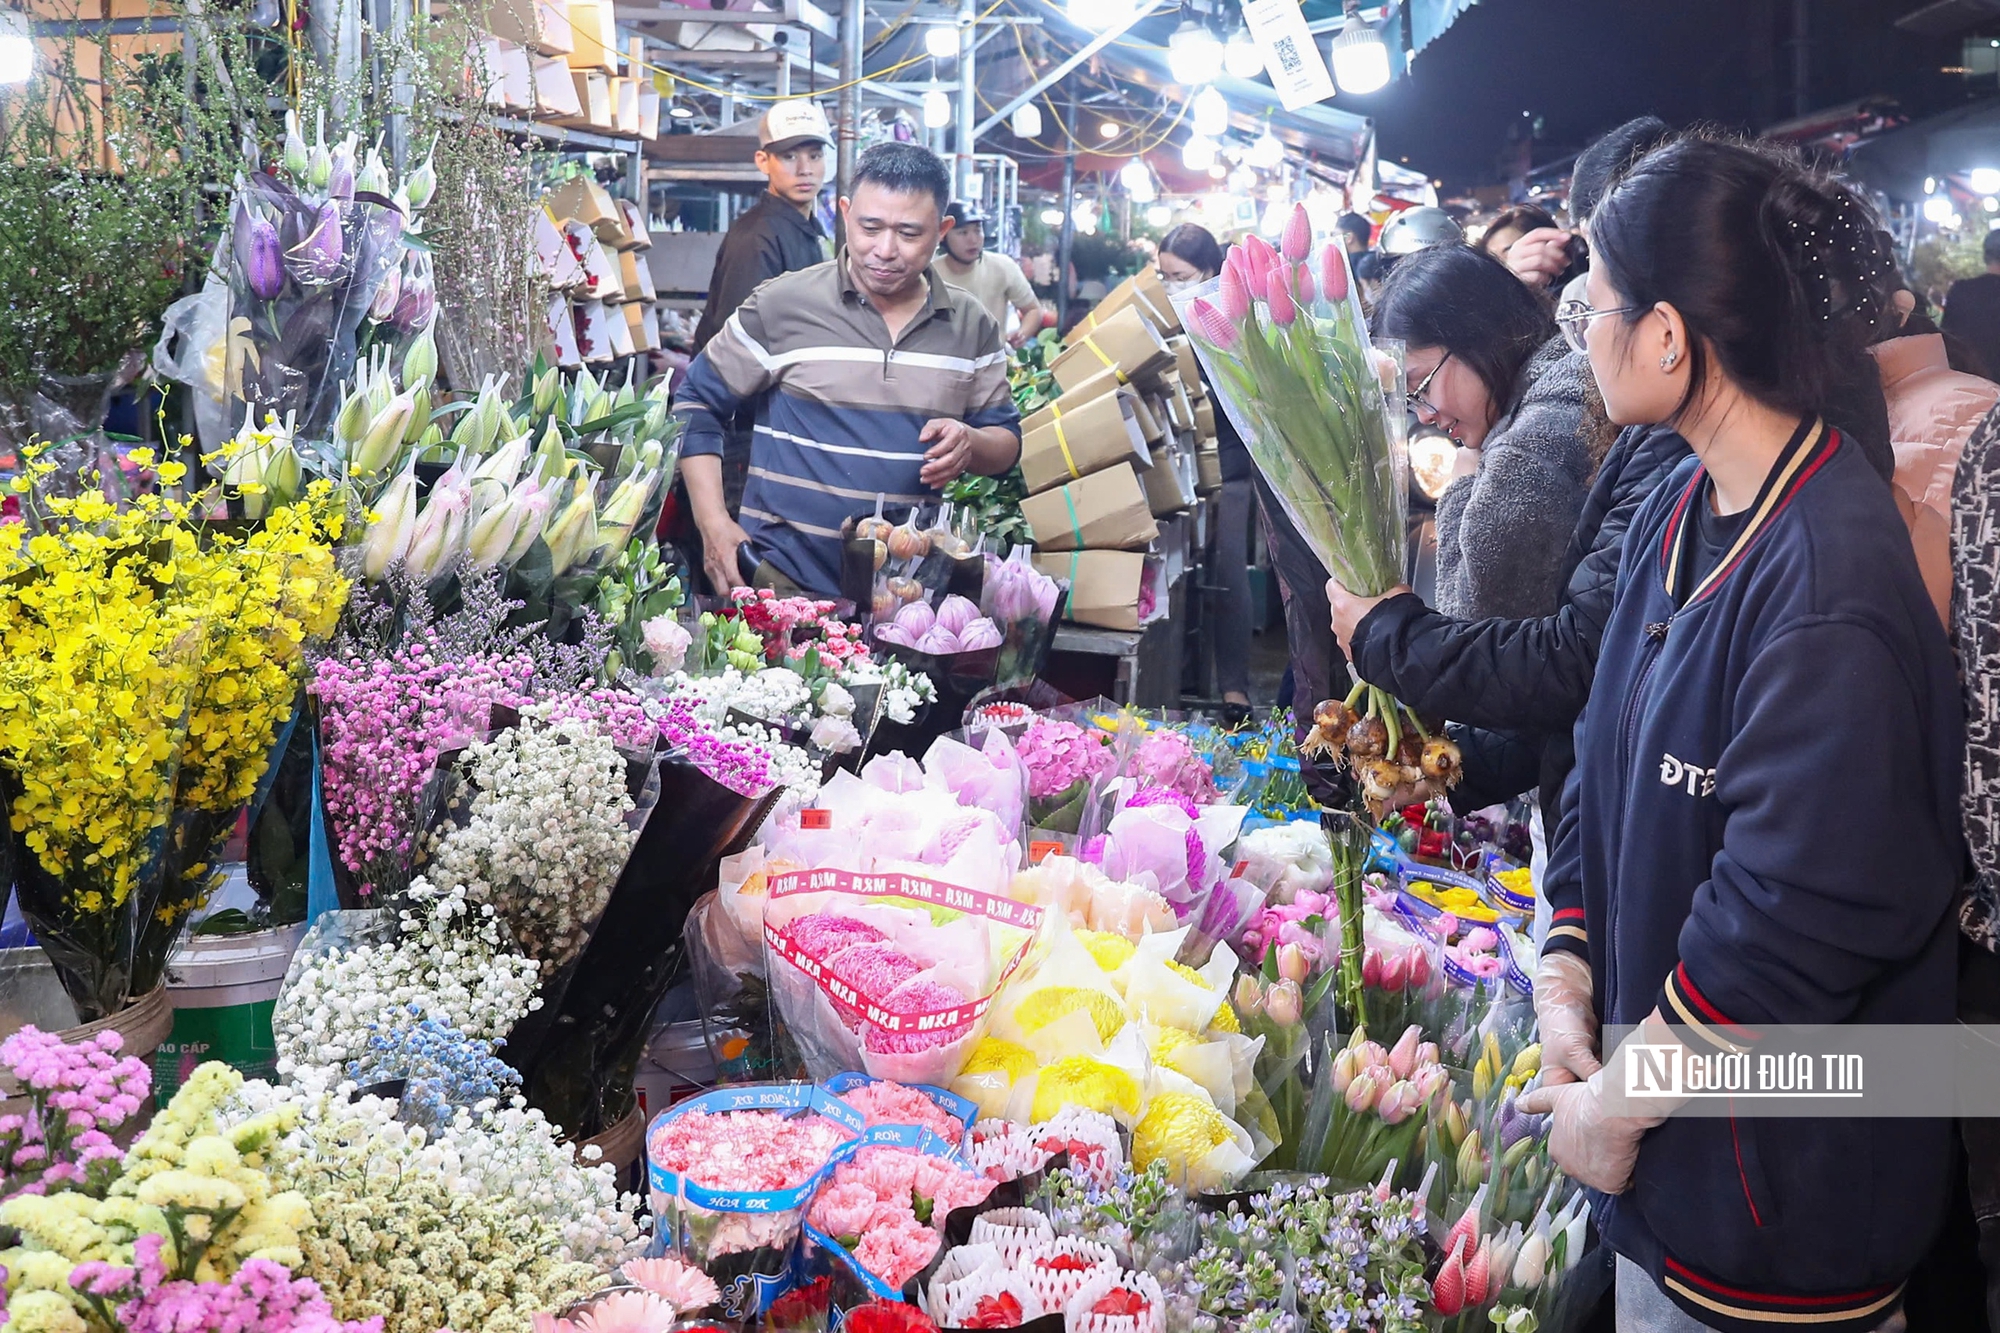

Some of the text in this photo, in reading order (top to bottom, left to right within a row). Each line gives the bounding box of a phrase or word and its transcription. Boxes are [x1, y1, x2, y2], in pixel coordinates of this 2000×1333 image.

[795, 951, 821, 979] M&A
[829, 978, 857, 1007] M&A
[867, 1004, 900, 1031] M&A
[918, 1010, 959, 1030] M&A
[157, 1040, 210, 1054] AO CẤP
[707, 1197, 739, 1208] HOA
[746, 1198, 770, 1210] DK
